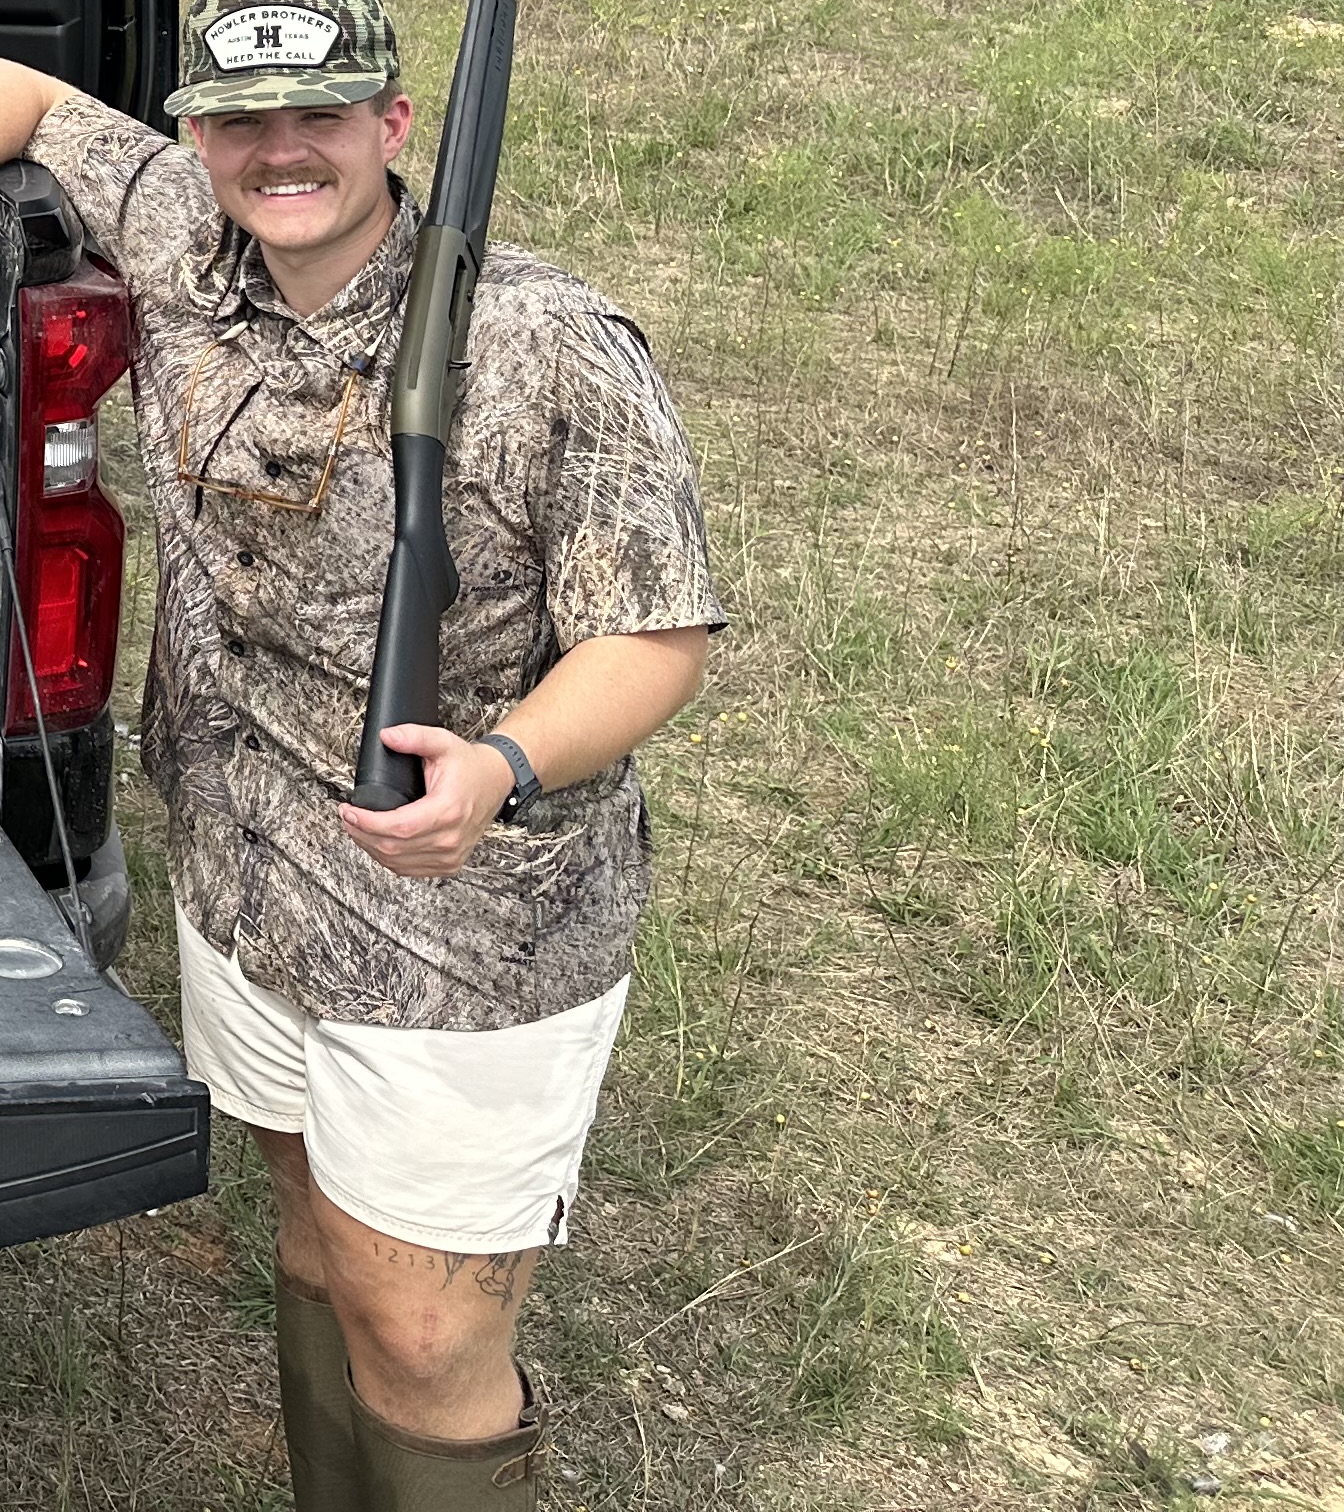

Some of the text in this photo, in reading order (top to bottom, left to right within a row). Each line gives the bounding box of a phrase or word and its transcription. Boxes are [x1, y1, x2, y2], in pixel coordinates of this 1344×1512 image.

[210, 10, 332, 40] HOWLER BROTHERS
[253, 21, 283, 49] H
[226, 51, 315, 64] HEED THE CALL
[373, 1242, 436, 1271] 1213
